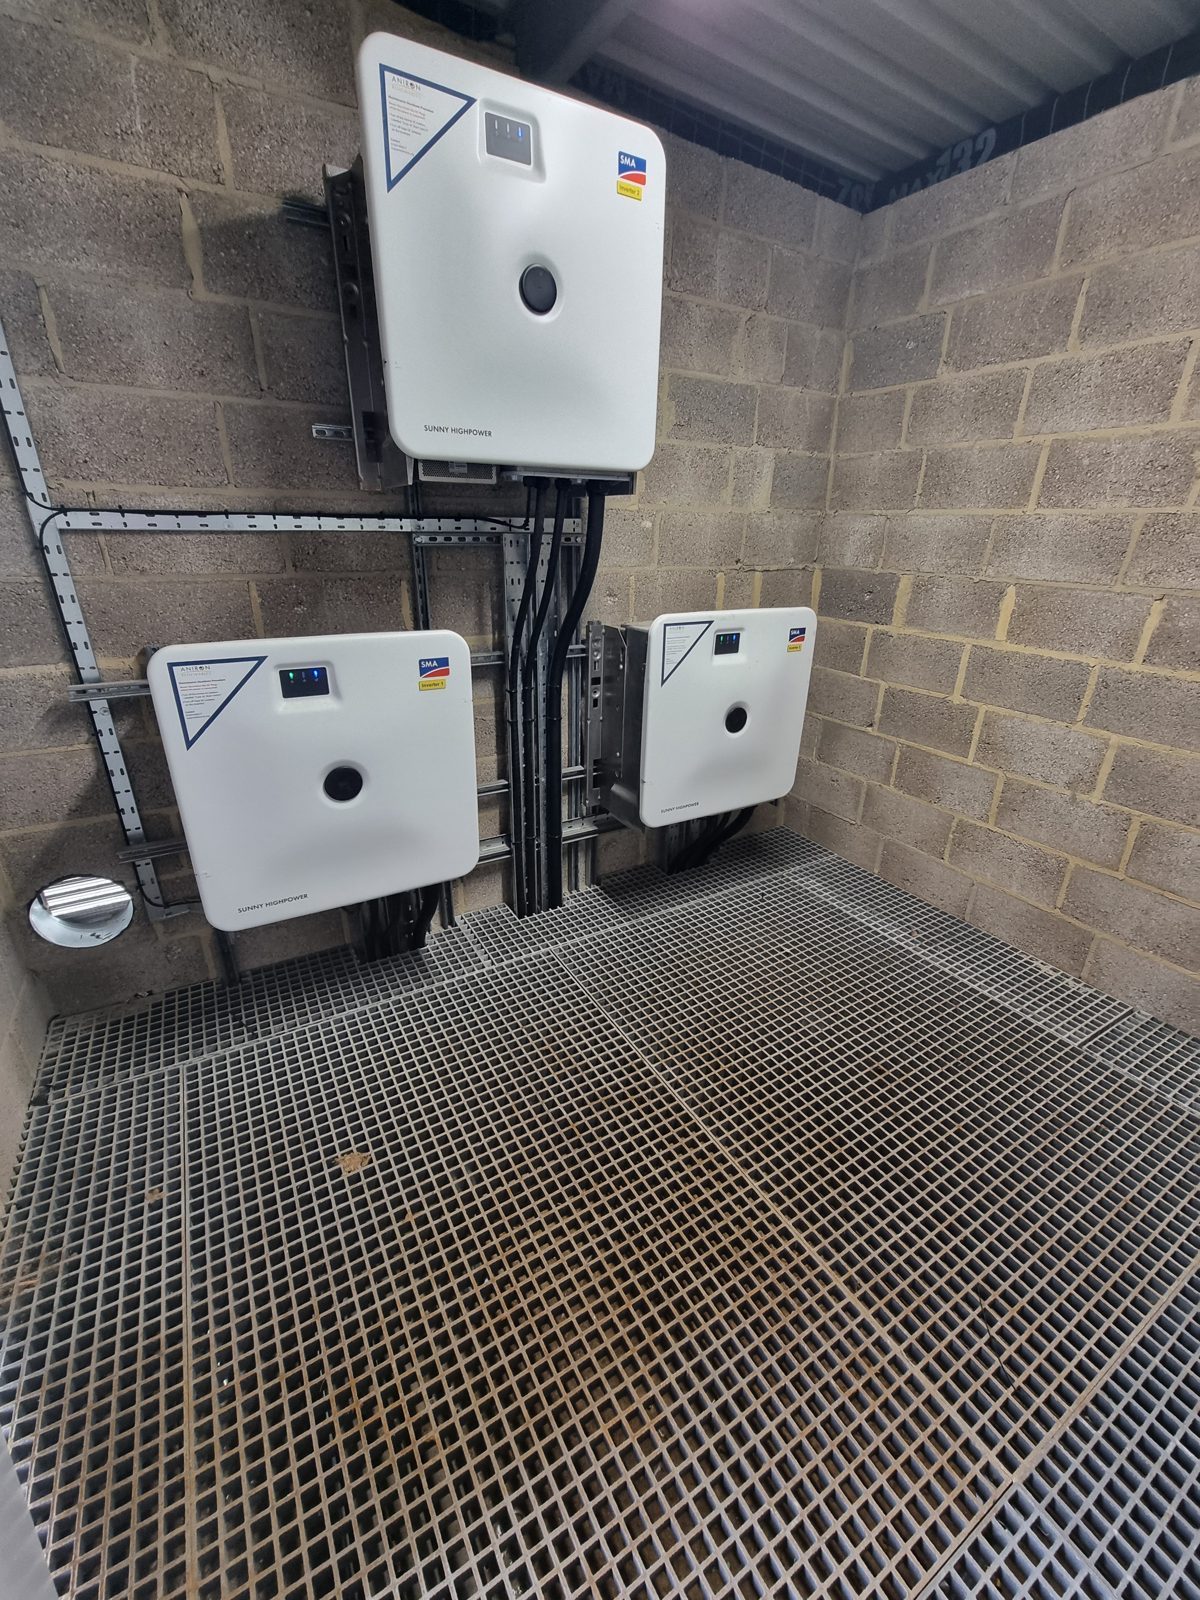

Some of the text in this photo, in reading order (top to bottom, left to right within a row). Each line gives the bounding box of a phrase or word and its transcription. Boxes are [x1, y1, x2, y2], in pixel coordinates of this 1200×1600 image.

[620, 154, 636, 169] SMA
[423, 424, 493, 437] SUNNY HIGHPOWER
[421, 660, 438, 668] SMA
[237, 893, 308, 914] SUNNY HIGHPOWER
